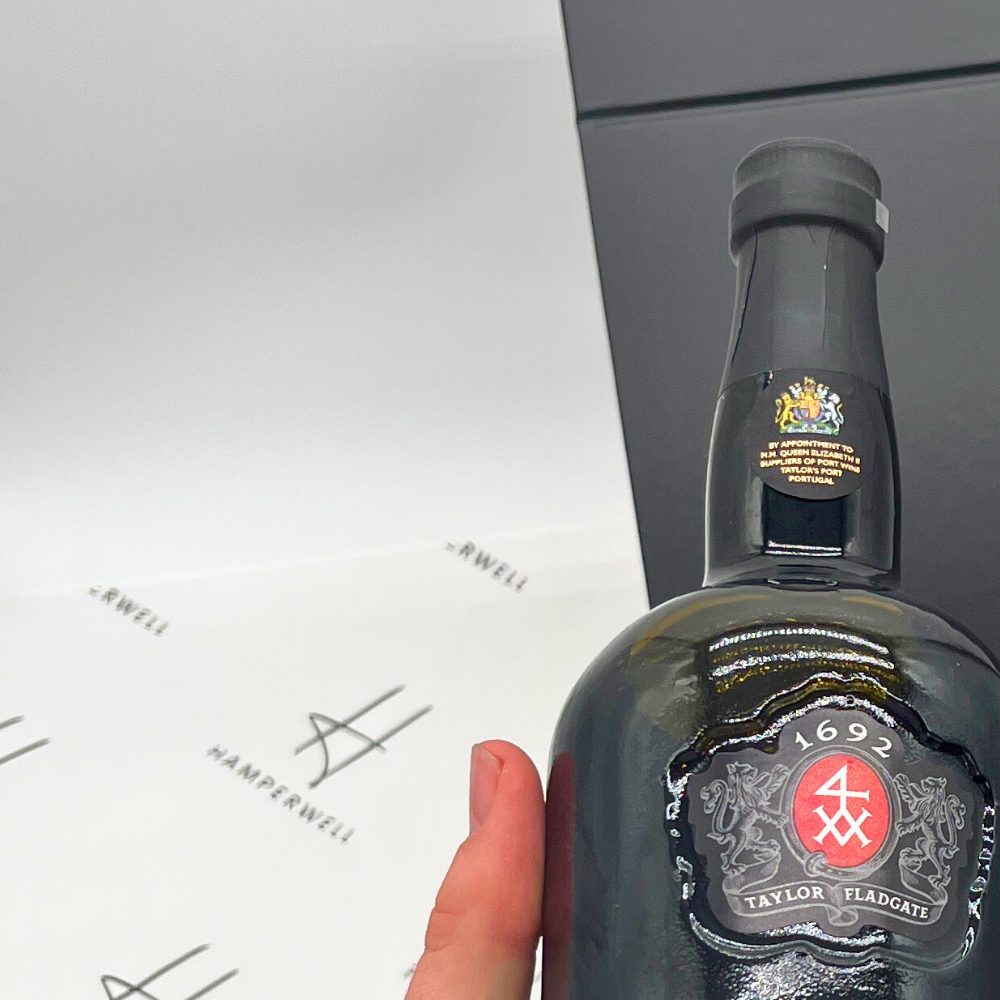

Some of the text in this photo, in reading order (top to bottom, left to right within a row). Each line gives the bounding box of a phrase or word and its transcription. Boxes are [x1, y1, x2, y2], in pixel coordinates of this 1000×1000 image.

[768, 440, 854, 453] BY APPOINTMENT TO
[760, 458, 803, 468] SUPPLIERS
[804, 457, 816, 465] OF
[817, 458, 839, 468] PORT
[780, 449, 810, 457] QUEEN
[811, 449, 854, 463] ELIZABETH
[820, 467, 842, 477] PORT
[788, 475, 835, 486] PORTUGAL
[794, 719, 893, 758] 1692
[206, 743, 356, 845] HAMPERWELL
[744, 886, 929, 920] TAYLOR FLADGATE
